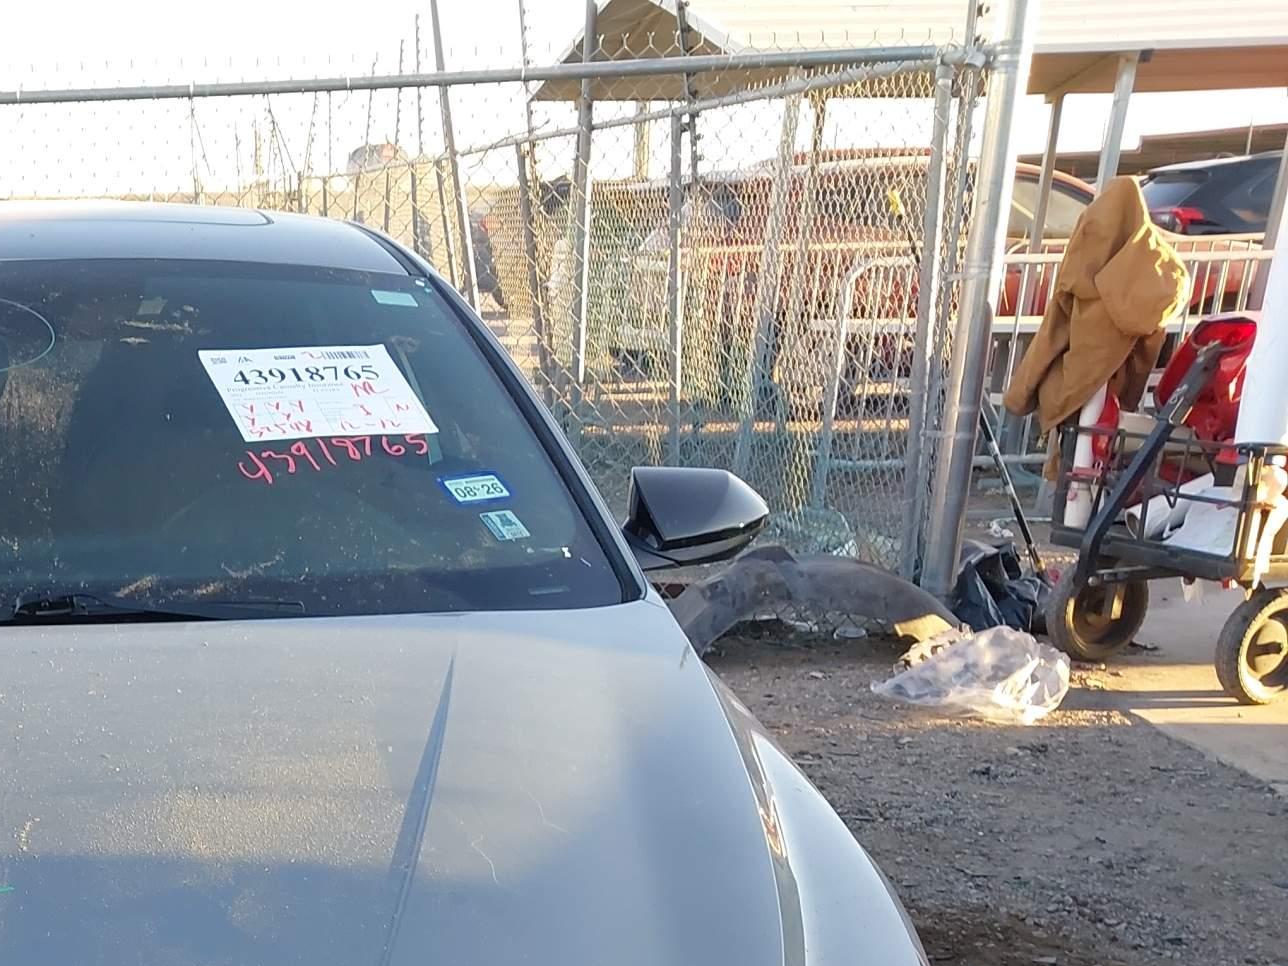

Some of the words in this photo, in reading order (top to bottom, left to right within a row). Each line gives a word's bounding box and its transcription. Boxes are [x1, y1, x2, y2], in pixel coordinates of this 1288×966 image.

[233, 364, 379, 385] 43918765
[238, 433, 428, 484] 43918765
[454, 486, 477, 498] 08
[480, 482, 504, 495] 26
